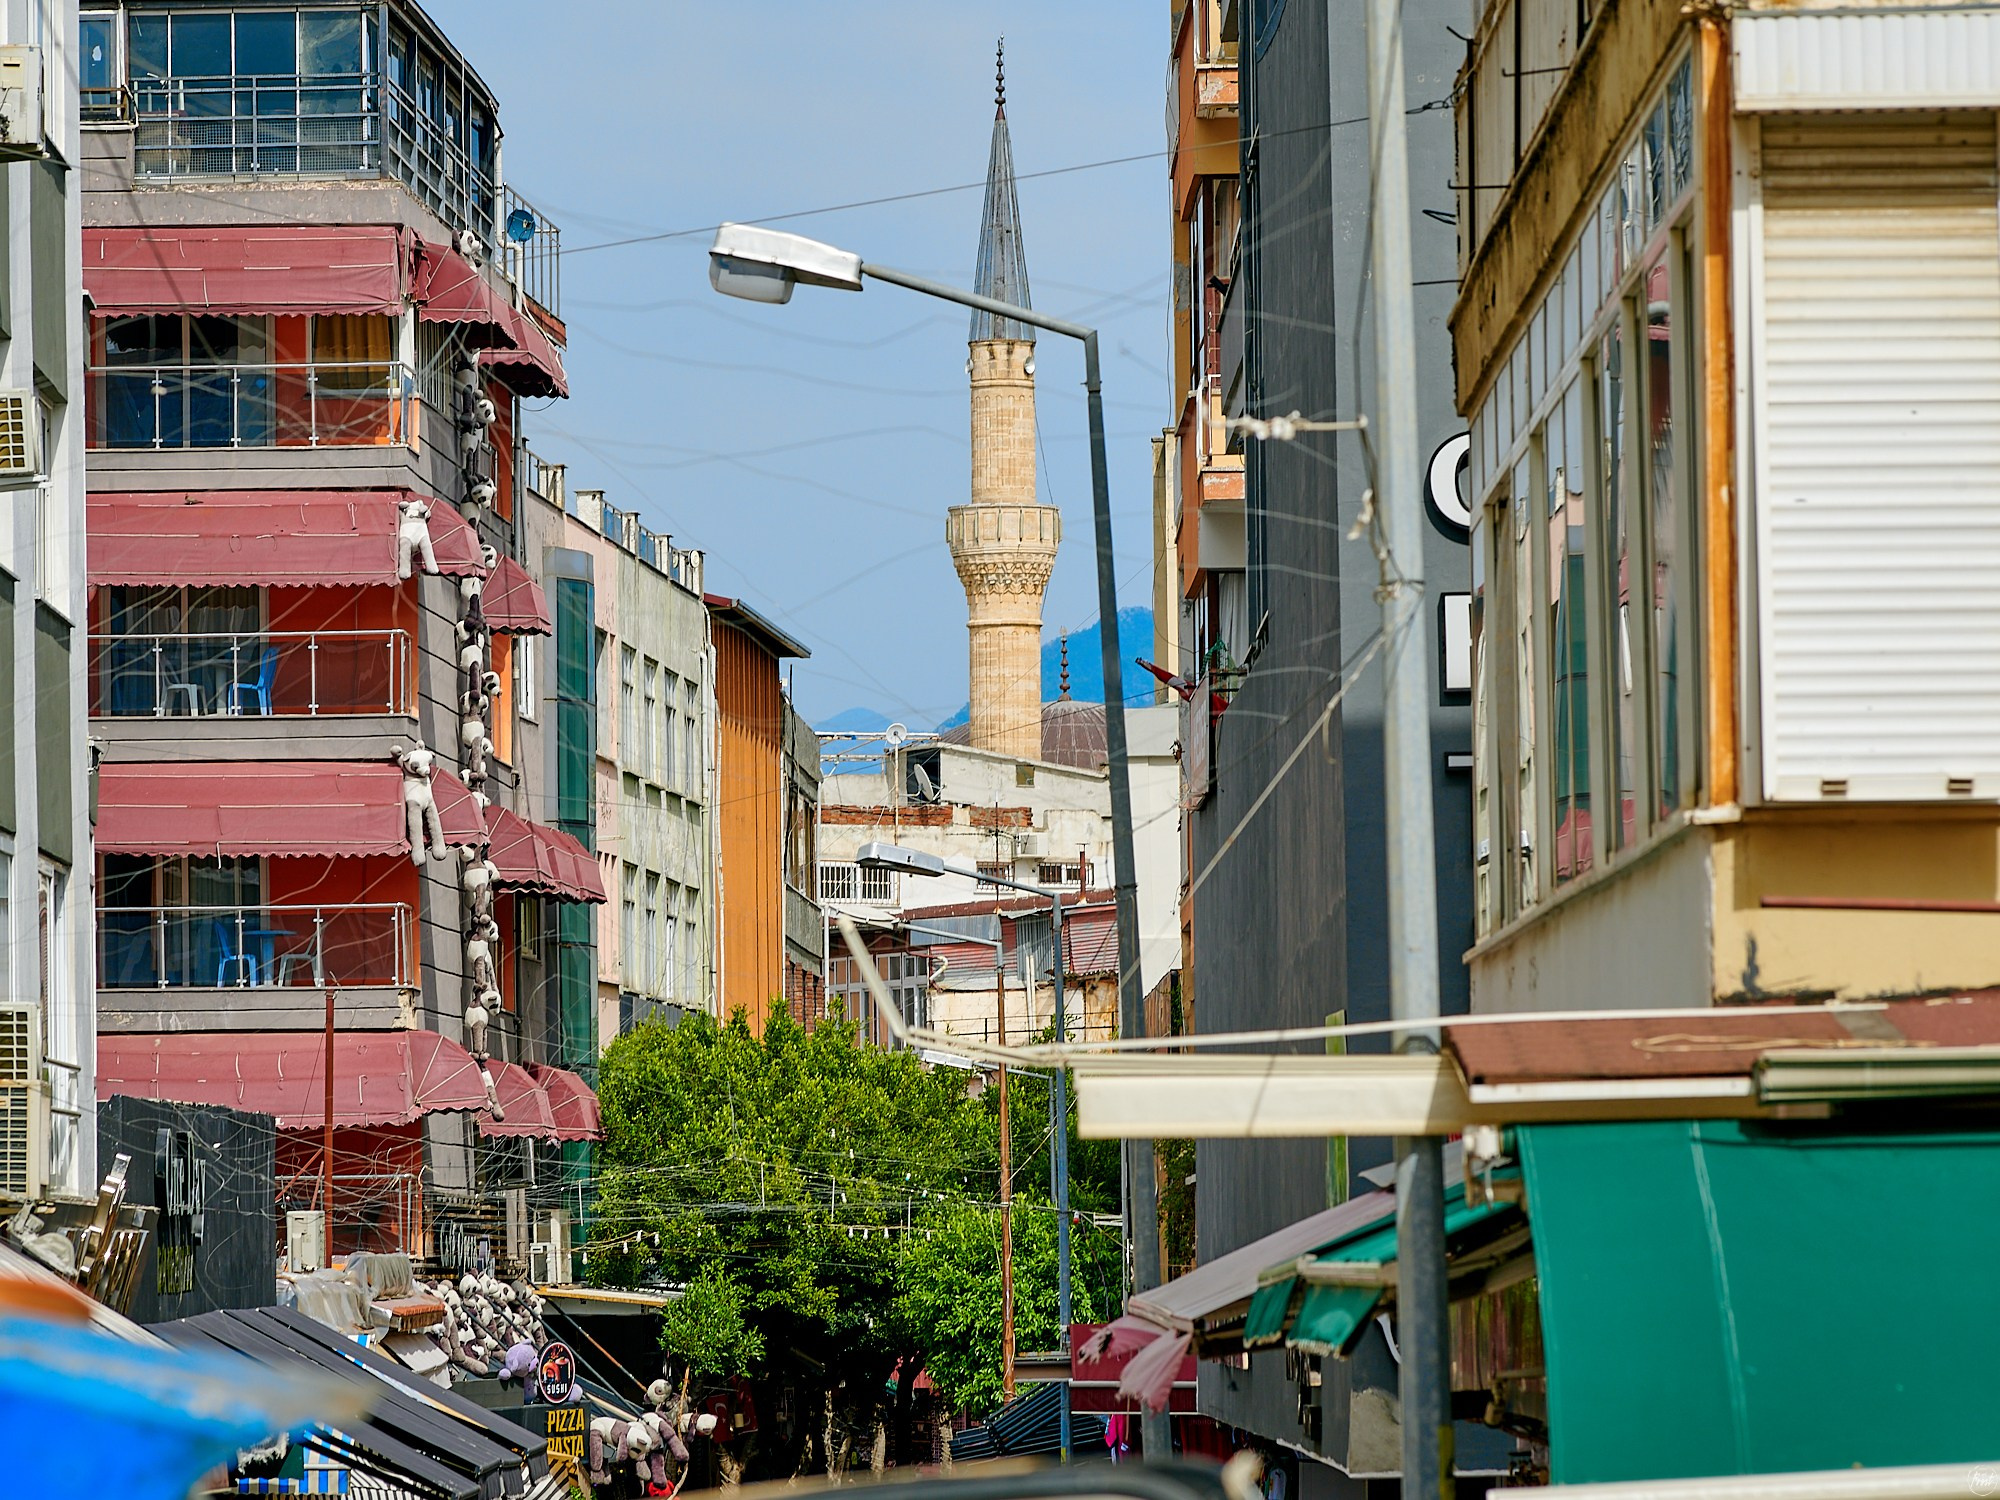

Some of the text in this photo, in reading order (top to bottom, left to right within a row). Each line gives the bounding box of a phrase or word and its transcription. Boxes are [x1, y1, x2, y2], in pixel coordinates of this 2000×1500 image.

[546, 1382, 568, 1395] SUSHI
[547, 1408, 585, 1433] PIZZA
[546, 1434, 585, 1457] PASTA
